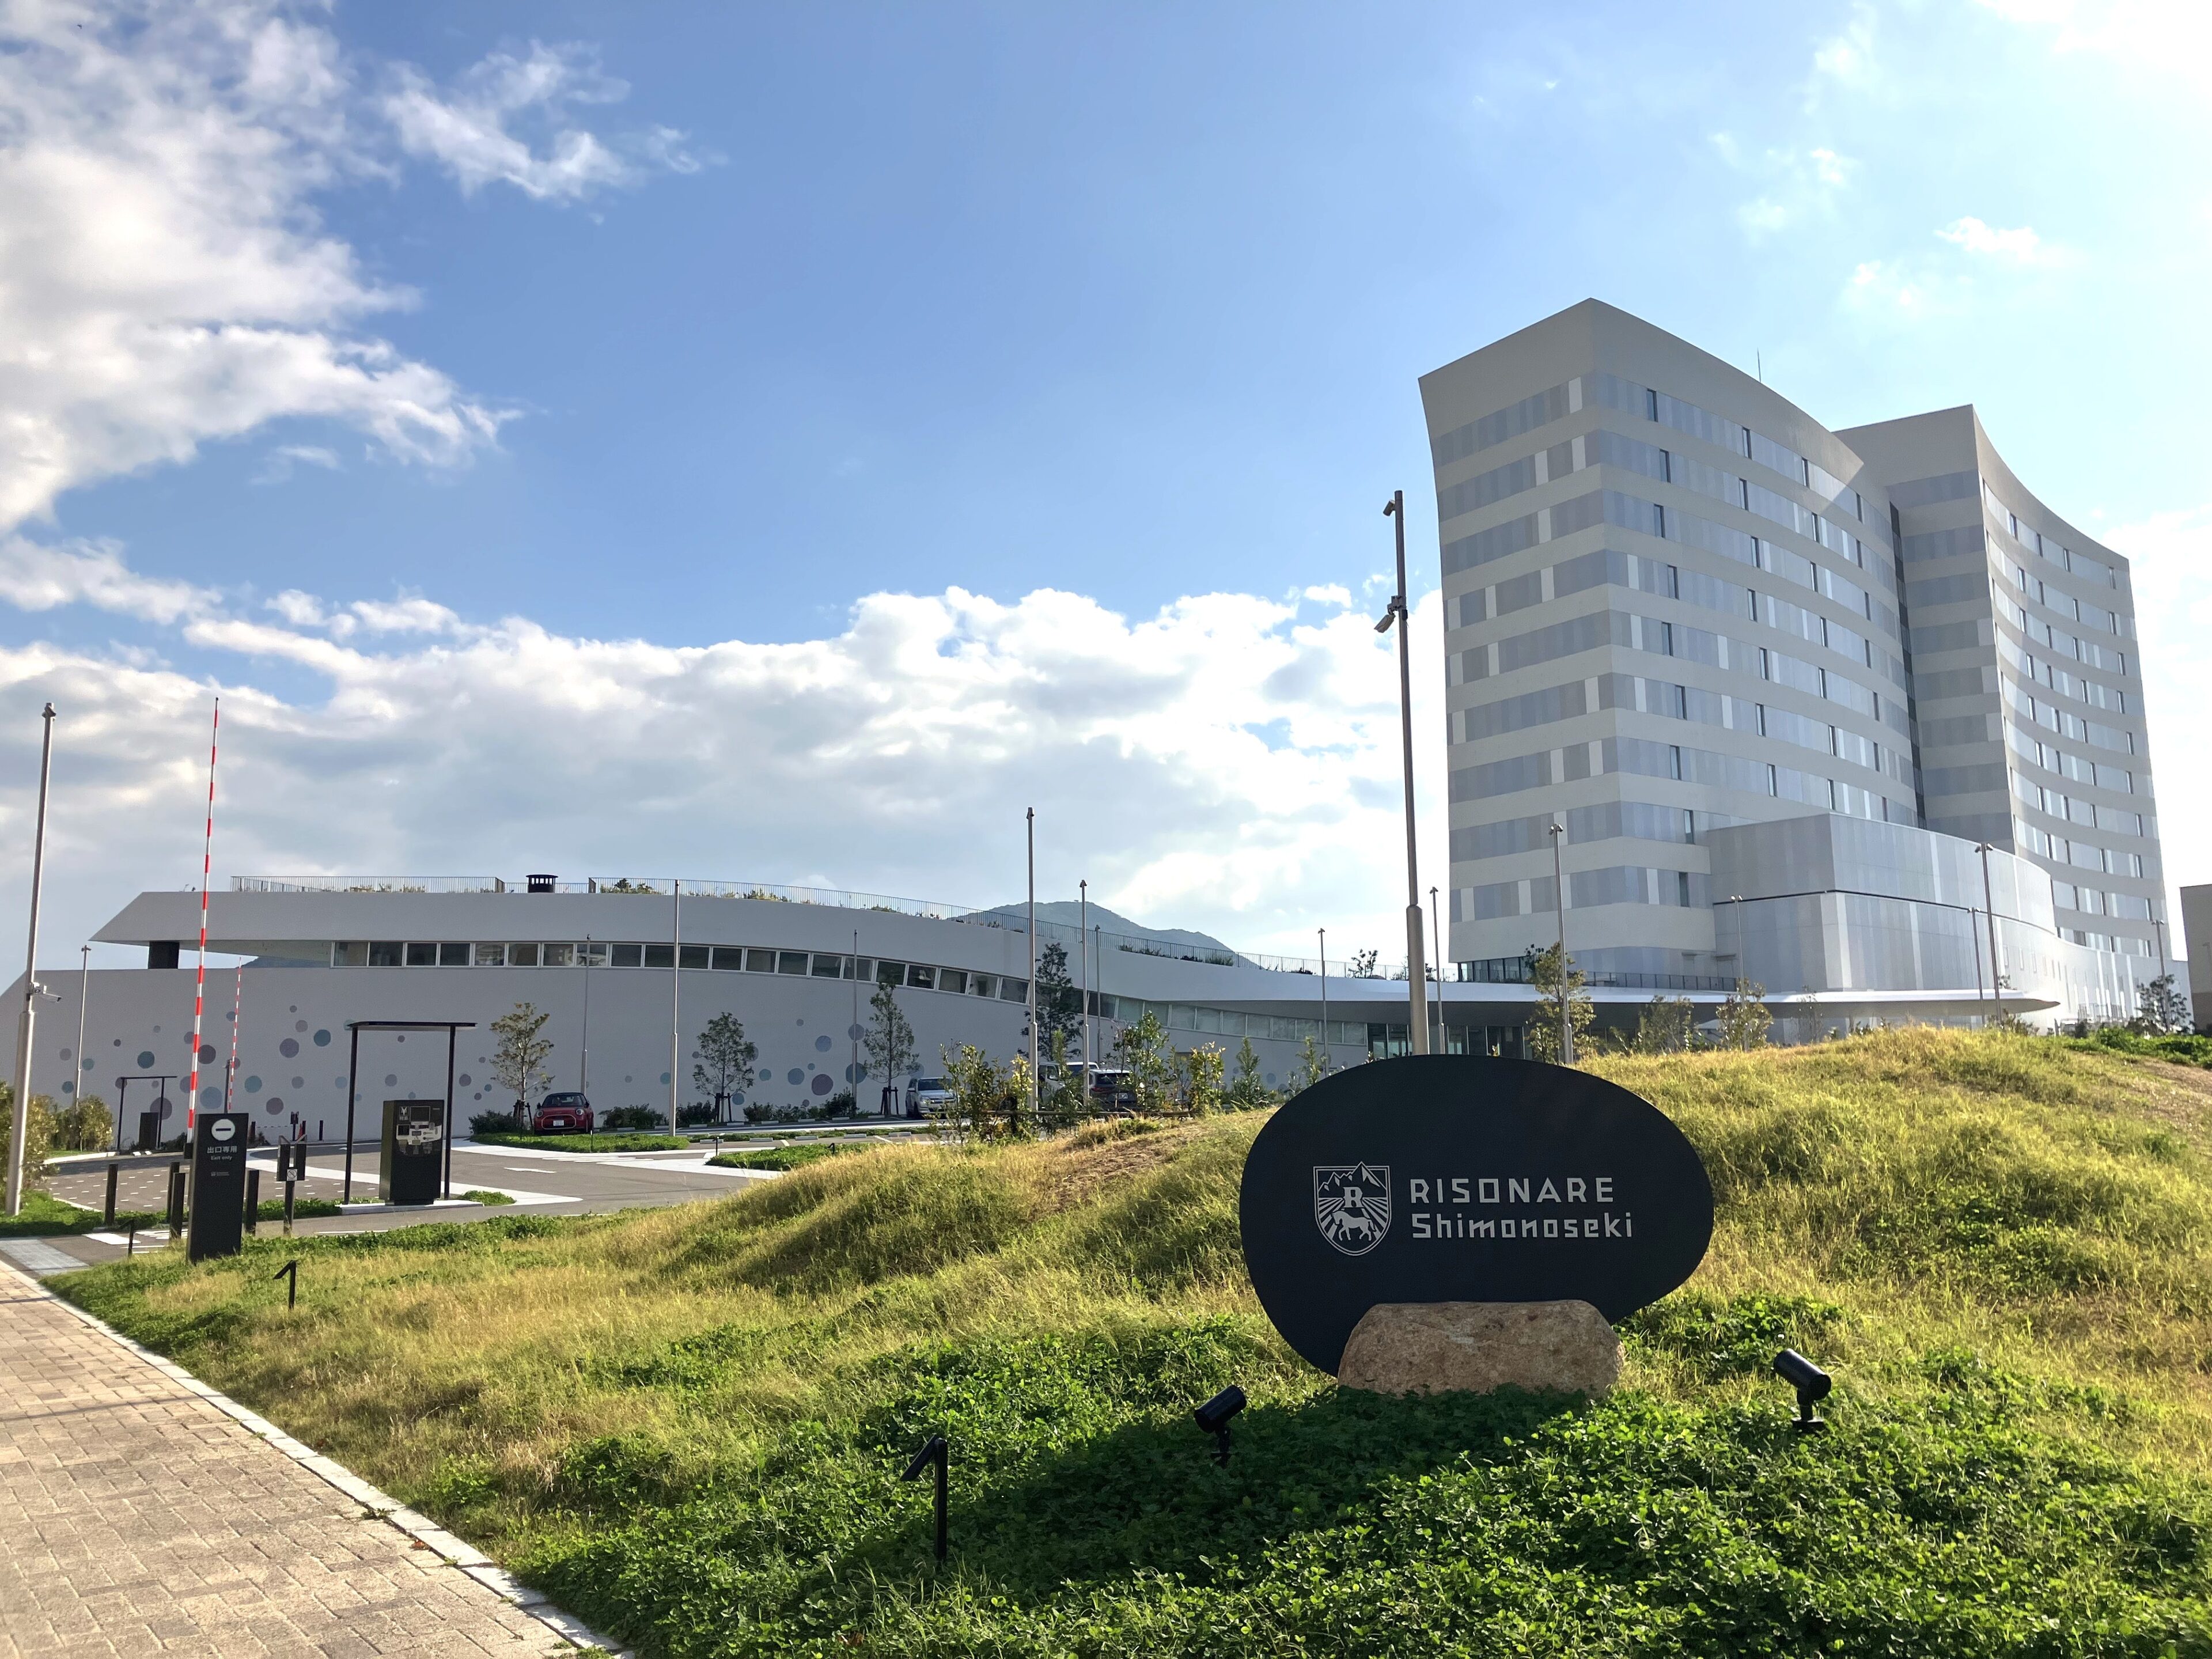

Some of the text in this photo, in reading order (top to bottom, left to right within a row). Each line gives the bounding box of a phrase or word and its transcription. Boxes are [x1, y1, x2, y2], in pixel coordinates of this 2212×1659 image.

[1342, 1187, 1365, 1208] R
[1410, 1177, 1613, 1204] RISONARE
[1411, 1212, 1633, 1238] Shimonoseki
